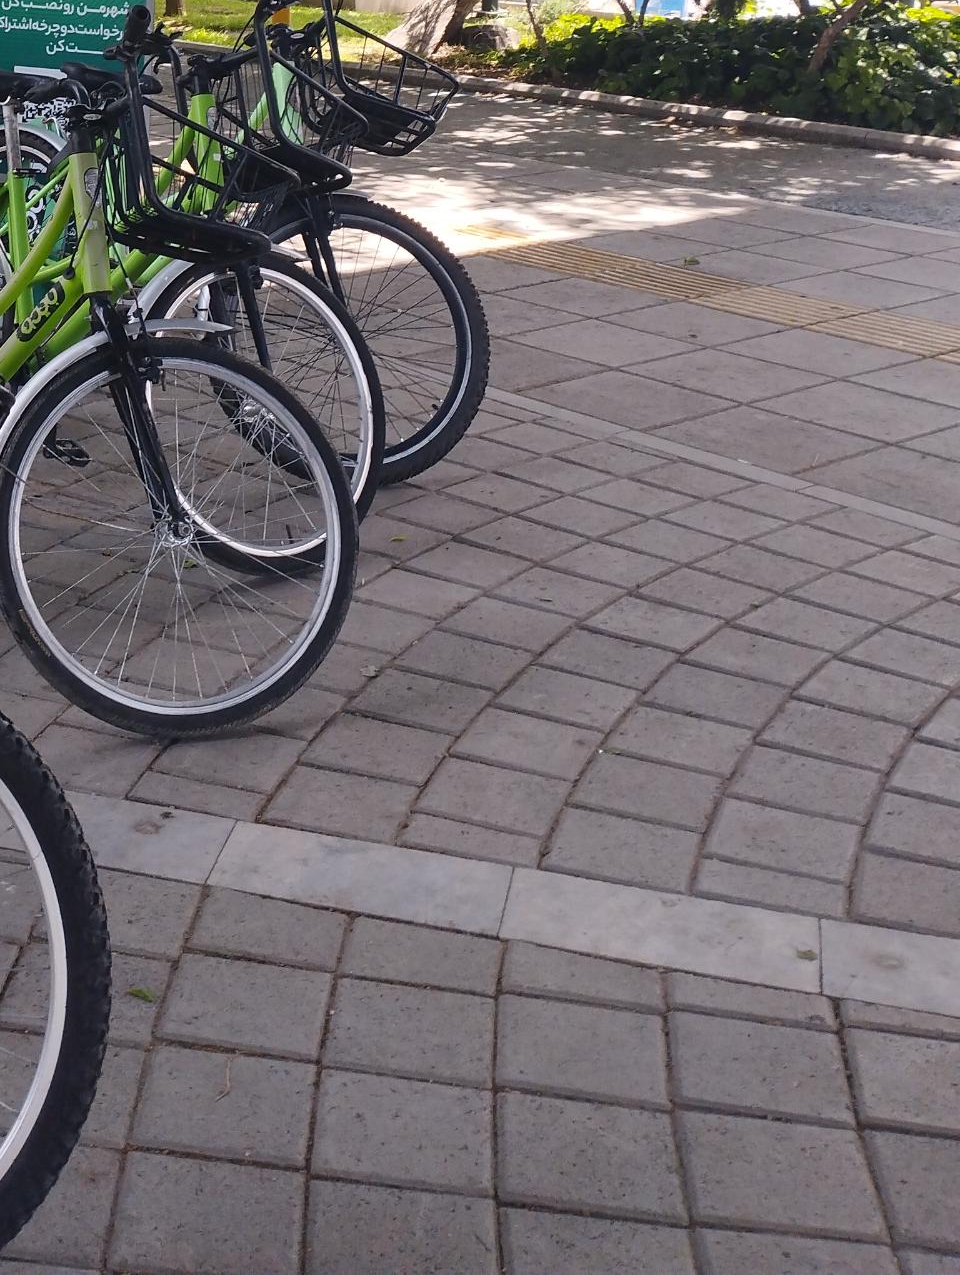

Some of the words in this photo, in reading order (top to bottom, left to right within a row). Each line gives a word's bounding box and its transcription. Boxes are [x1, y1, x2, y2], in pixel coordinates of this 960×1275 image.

[21, 0, 64, 12] نصب
[75, 24, 124, 40] رخواست
[46, 39, 65, 55] کن
